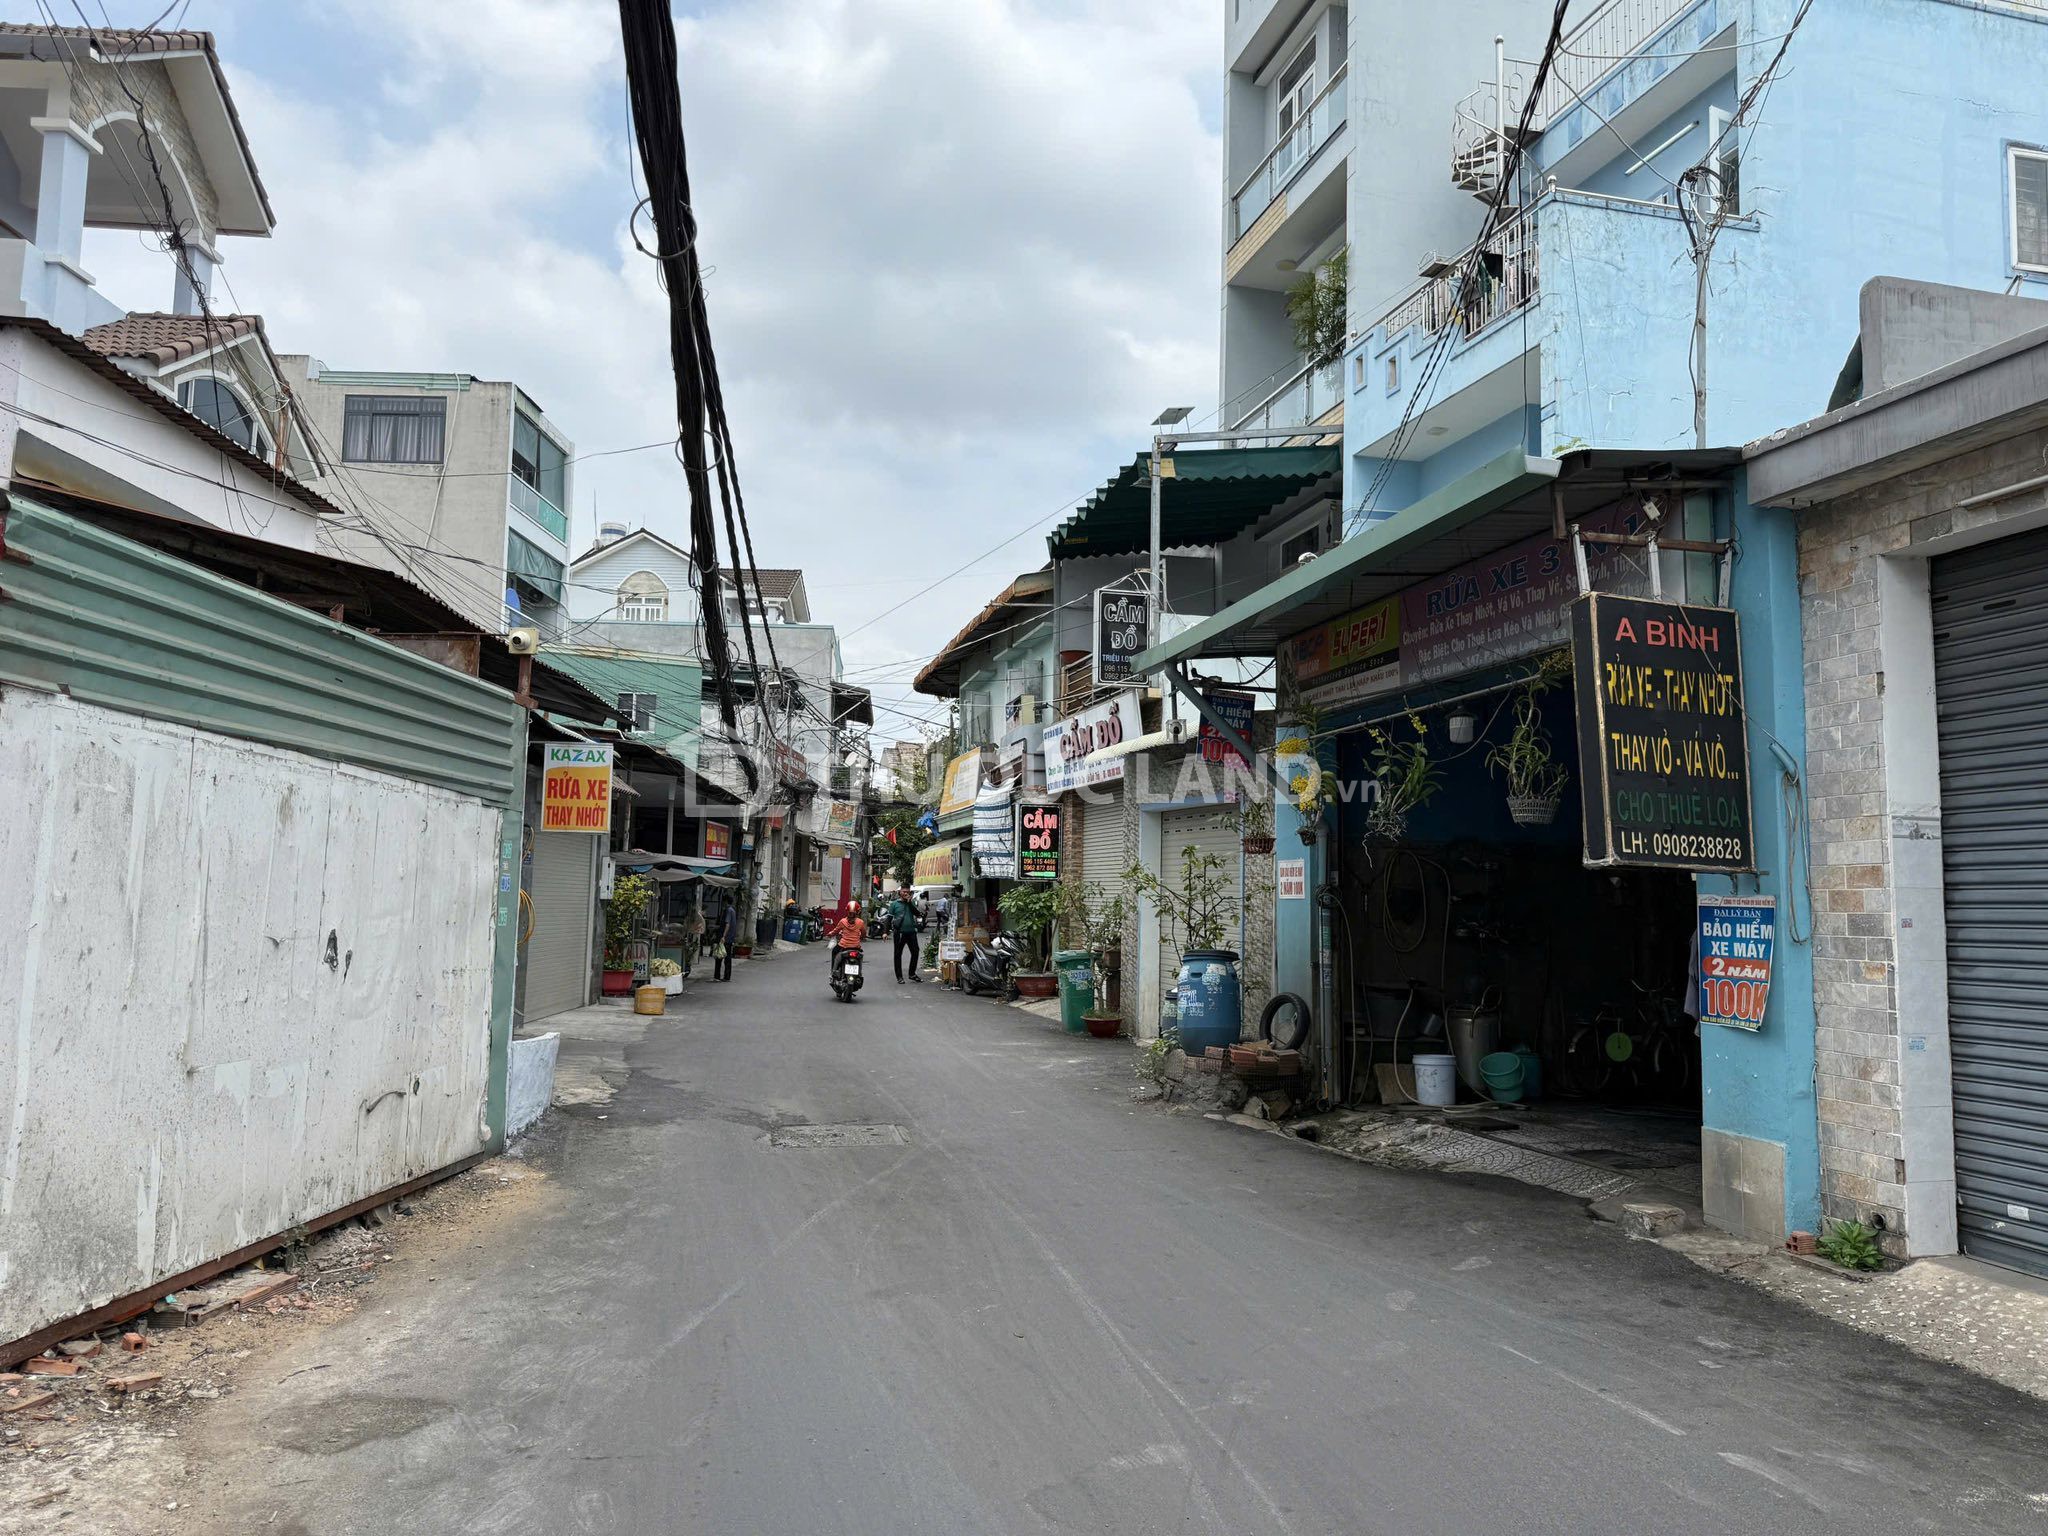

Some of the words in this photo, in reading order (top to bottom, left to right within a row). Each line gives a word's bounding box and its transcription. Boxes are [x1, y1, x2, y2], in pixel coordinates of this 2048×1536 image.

[1426, 573, 1482, 618] RỬA
[1488, 555, 1528, 595] XE
[1538, 544, 1561, 576] 3
[1526, 584, 1546, 604] Thay
[1104, 597, 1145, 624] CẦM
[1111, 624, 1137, 650] ĐỒ
[1614, 617, 1637, 643] A
[1646, 613, 1719, 652] BÌNH
[1663, 669, 1697, 714] THAY
[1697, 666, 1735, 718] NHỚT
[1060, 716, 1094, 761] CẦM
[1096, 698, 1123, 749] ĐỒ
[550, 748, 606, 763] KAZAX
[1611, 732, 1648, 772] THAY
[1651, 728, 1672, 775] VỎ
[1682, 731, 1703, 777] VÁ
[1704, 731, 1739, 780] VỎ...
[547, 771, 581, 801] RỬA
[587, 778, 608, 801] XE
[546, 804, 573, 827] THAY
[575, 803, 607, 827] NHỚT
[1023, 808, 1058, 829] CẦM
[1617, 789, 1654, 825] CHO
[1658, 788, 1702, 828] THUÊ
[1708, 797, 1742, 829] LOA
[1029, 829, 1051, 850] ĐỒ
[1621, 830, 1649, 855] LH:
[1653, 835, 1742, 860] 0908238828
[1703, 918, 1732, 938] BẢO
[1736, 919, 1773, 940] HIỂM
[1711, 941, 1729, 956] XE
[1733, 940, 1766, 959] MÁY
[1711, 958, 1726, 977] 2
[1727, 965, 1767, 979] NĂM
[1703, 978, 1769, 1021] 100K
